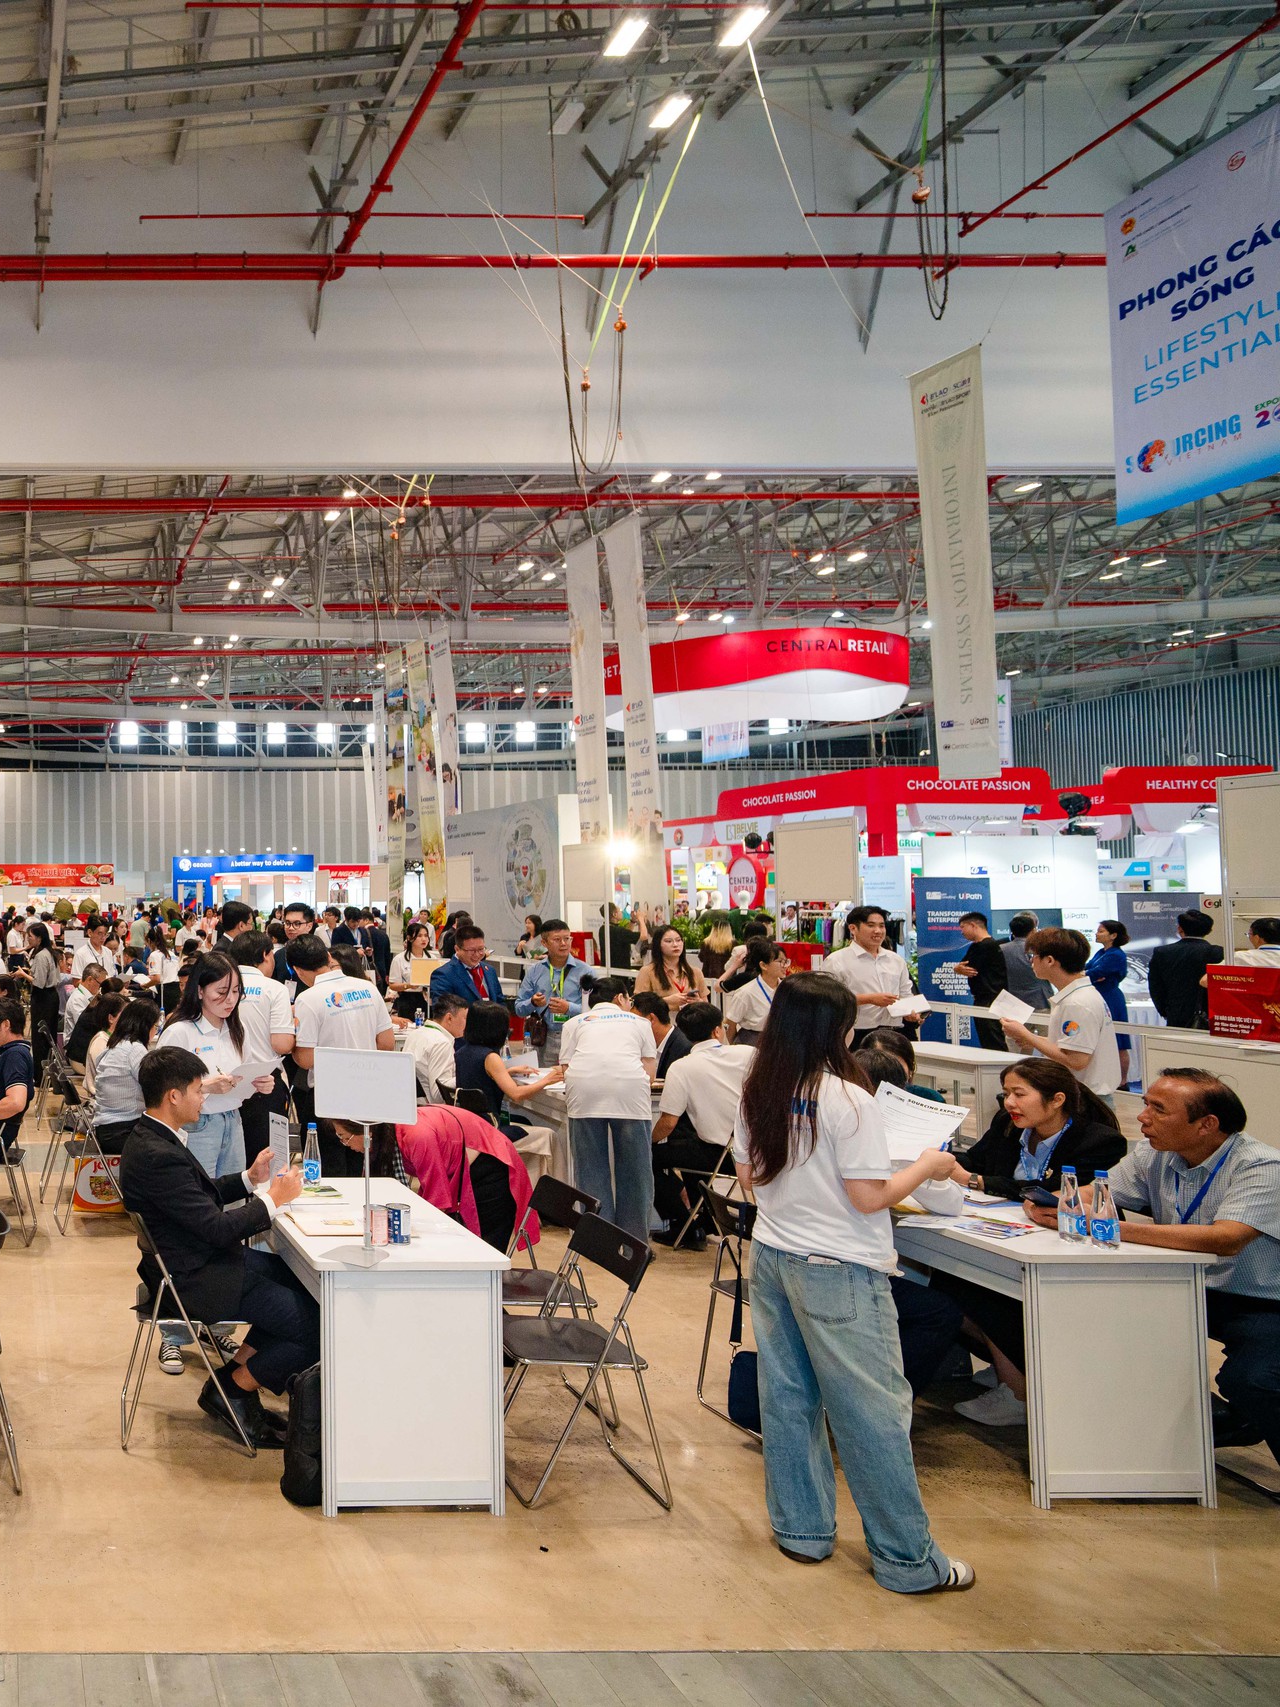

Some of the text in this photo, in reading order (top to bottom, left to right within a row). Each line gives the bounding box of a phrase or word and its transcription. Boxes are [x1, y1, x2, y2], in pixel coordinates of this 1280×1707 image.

[1119, 255, 1218, 321] PHONG
[1171, 266, 1254, 322] SỐNG
[1145, 291, 1280, 371] LIFESTYL
[942, 464, 973, 706] INFORMATION SYSTEMS
[907, 779, 1031, 791] CHOCOLATE PASSION
[1146, 780, 1198, 790] HEALTHY
[742, 789, 817, 808] CHOCOLATE PASSION
[898, 839, 921, 847] GROU
[1011, 863, 1050, 874] UiPath
[729, 876, 757, 885] CENTRAL
[958, 892, 983, 900] UiPath
[907, 1098, 939, 1111] SOURCING
[1092, 1222, 1111, 1233] ICY
